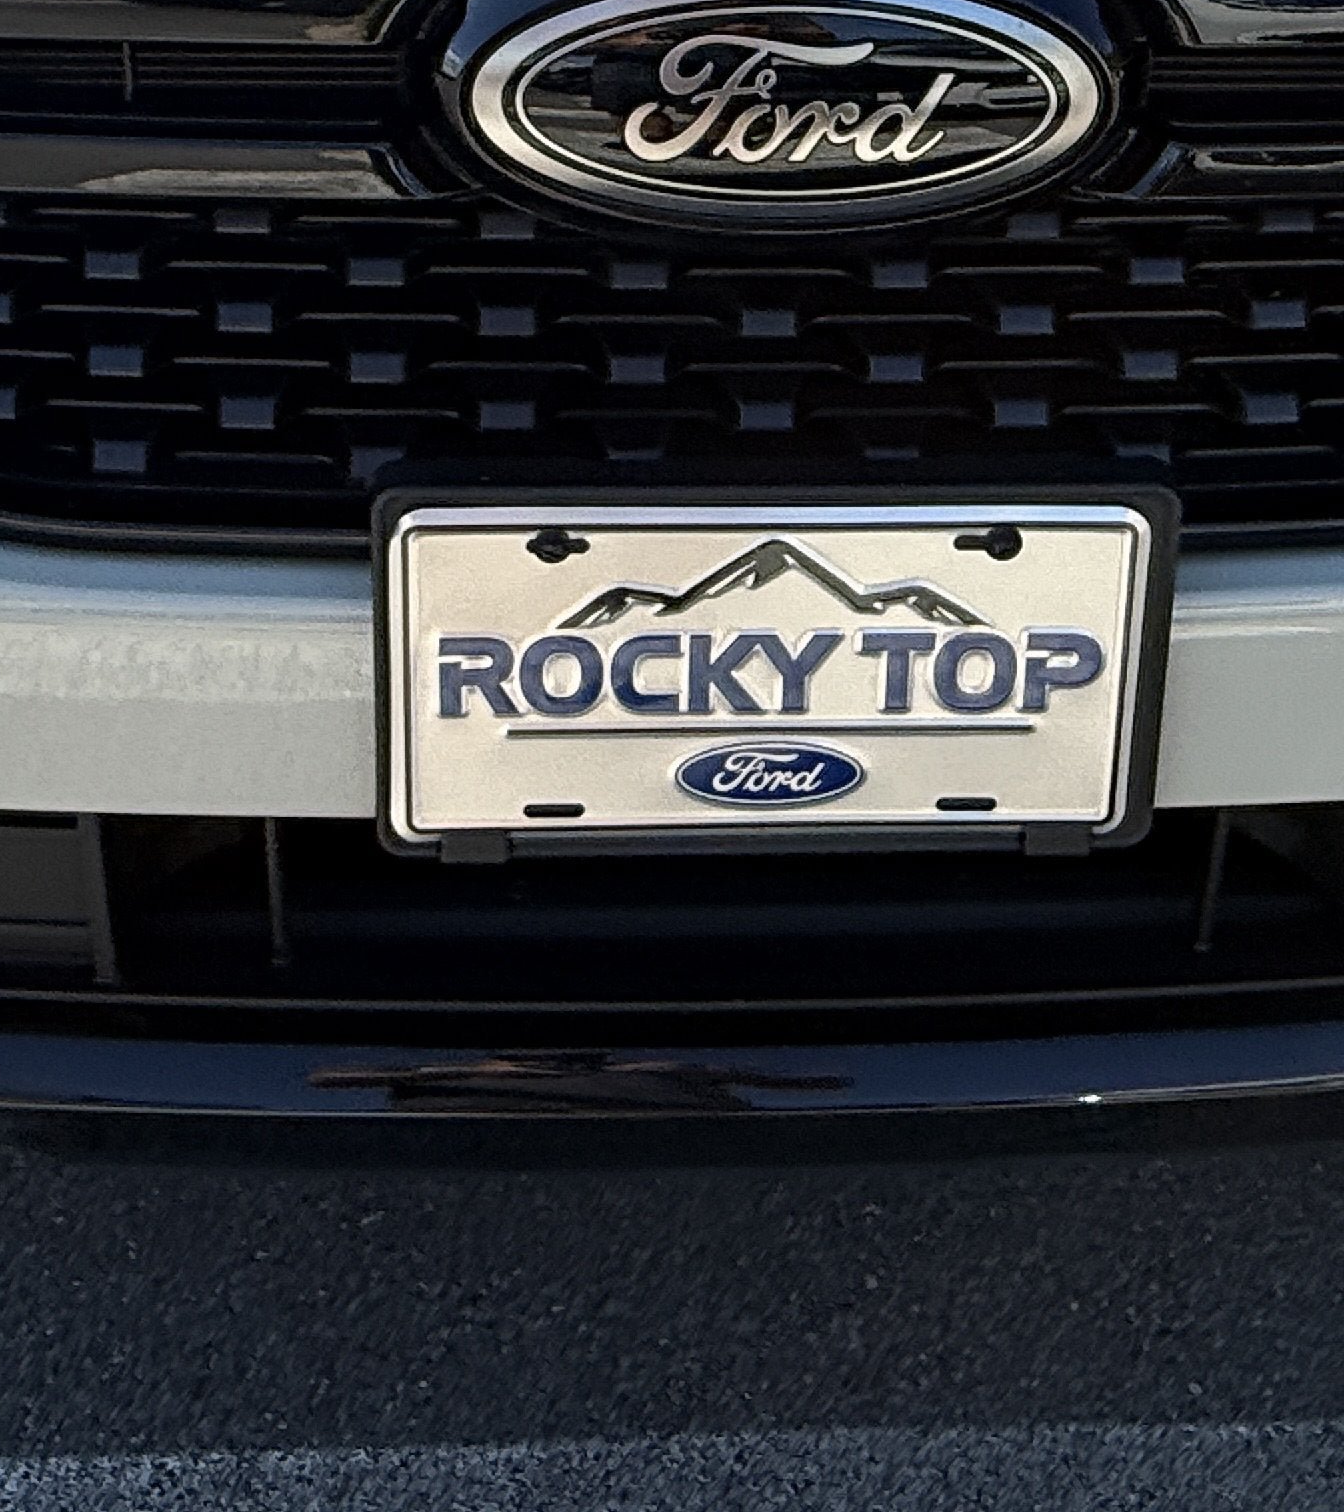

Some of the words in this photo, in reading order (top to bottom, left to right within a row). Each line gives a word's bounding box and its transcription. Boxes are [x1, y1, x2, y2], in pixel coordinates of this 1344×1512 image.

[623, 34, 955, 163] Ford
[437, 627, 844, 719] ROCKY
[860, 626, 1105, 716] TOP
[711, 749, 823, 796] Ford
